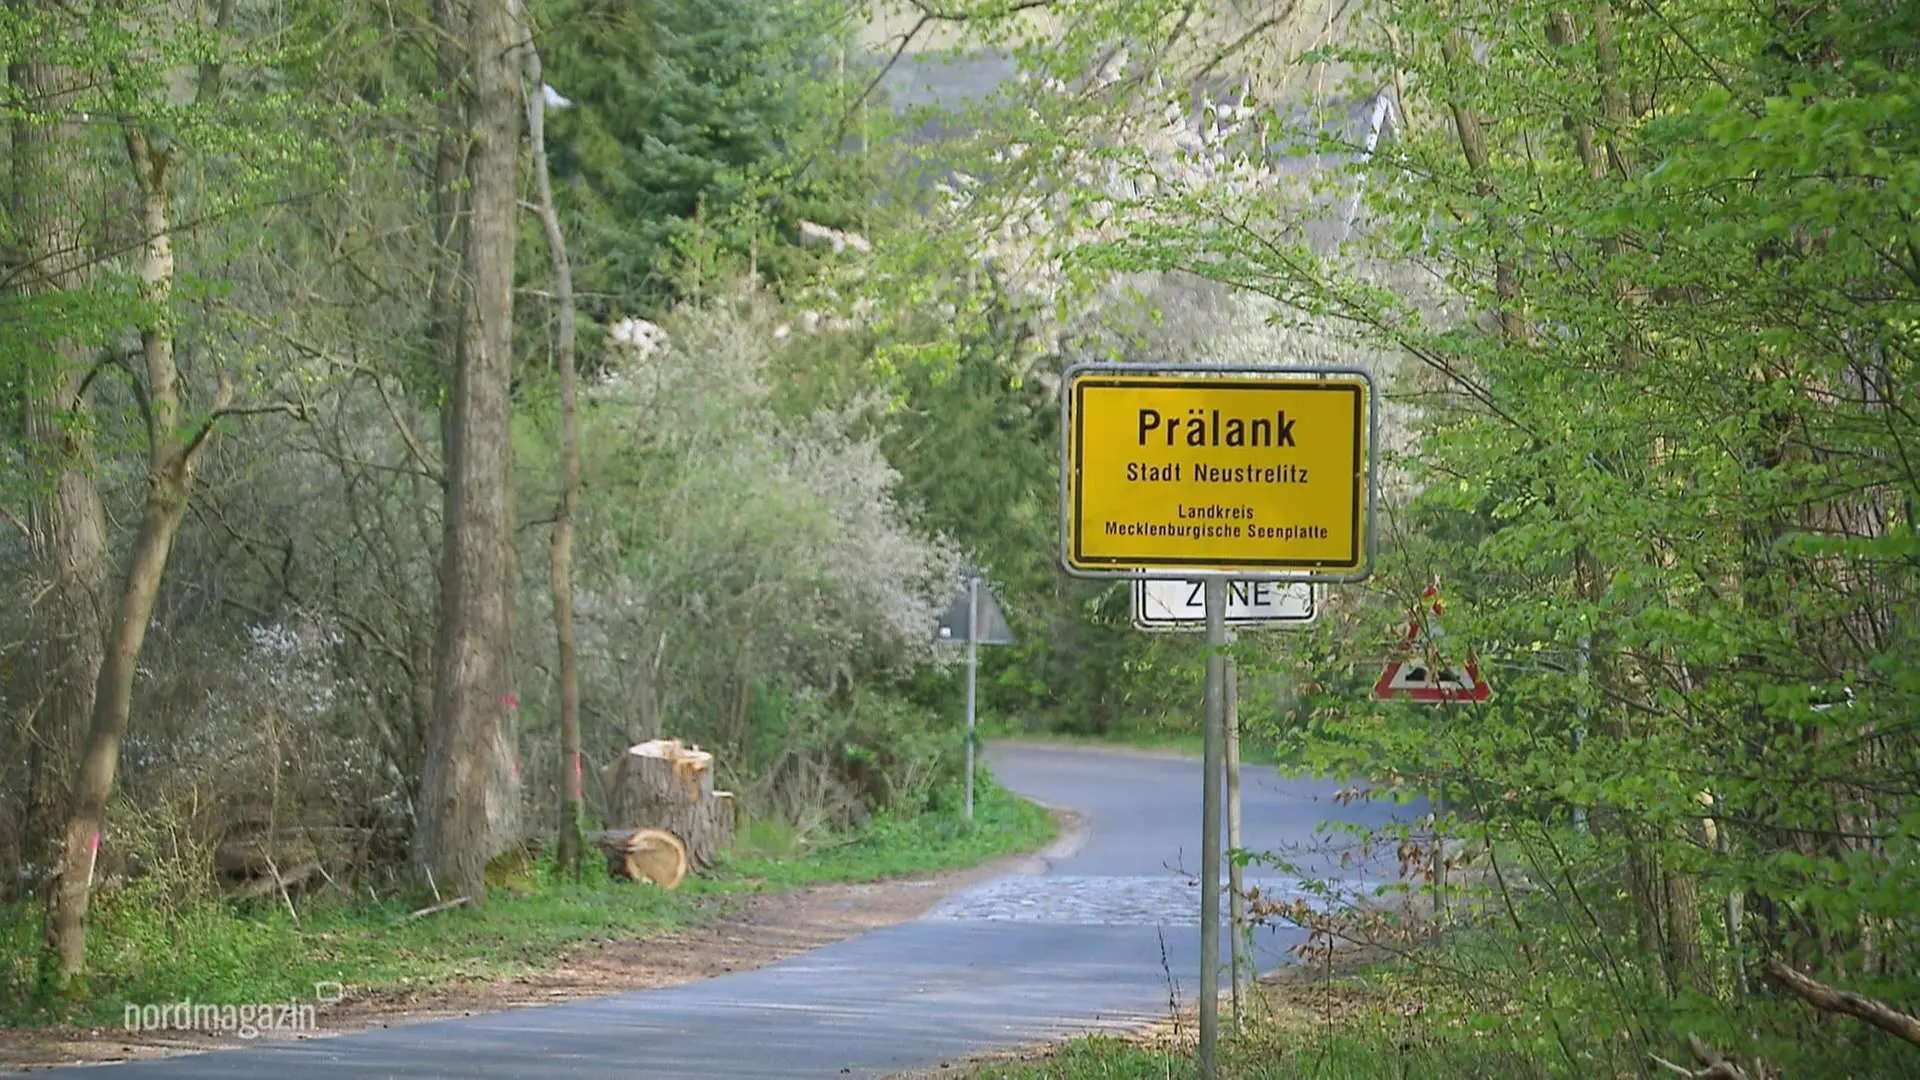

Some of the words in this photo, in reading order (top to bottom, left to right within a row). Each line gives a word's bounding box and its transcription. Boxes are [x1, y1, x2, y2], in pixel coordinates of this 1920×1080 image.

[1138, 408, 1296, 447] Prälank
[1126, 462, 1181, 482] Stadt
[1194, 463, 1308, 483] Neustrelitz
[1178, 504, 1254, 519] Landkreis
[1105, 521, 1240, 539] Mecklenburgische
[1248, 524, 1328, 541] Seenplatte
[1186, 580, 1271, 606] ZNE
